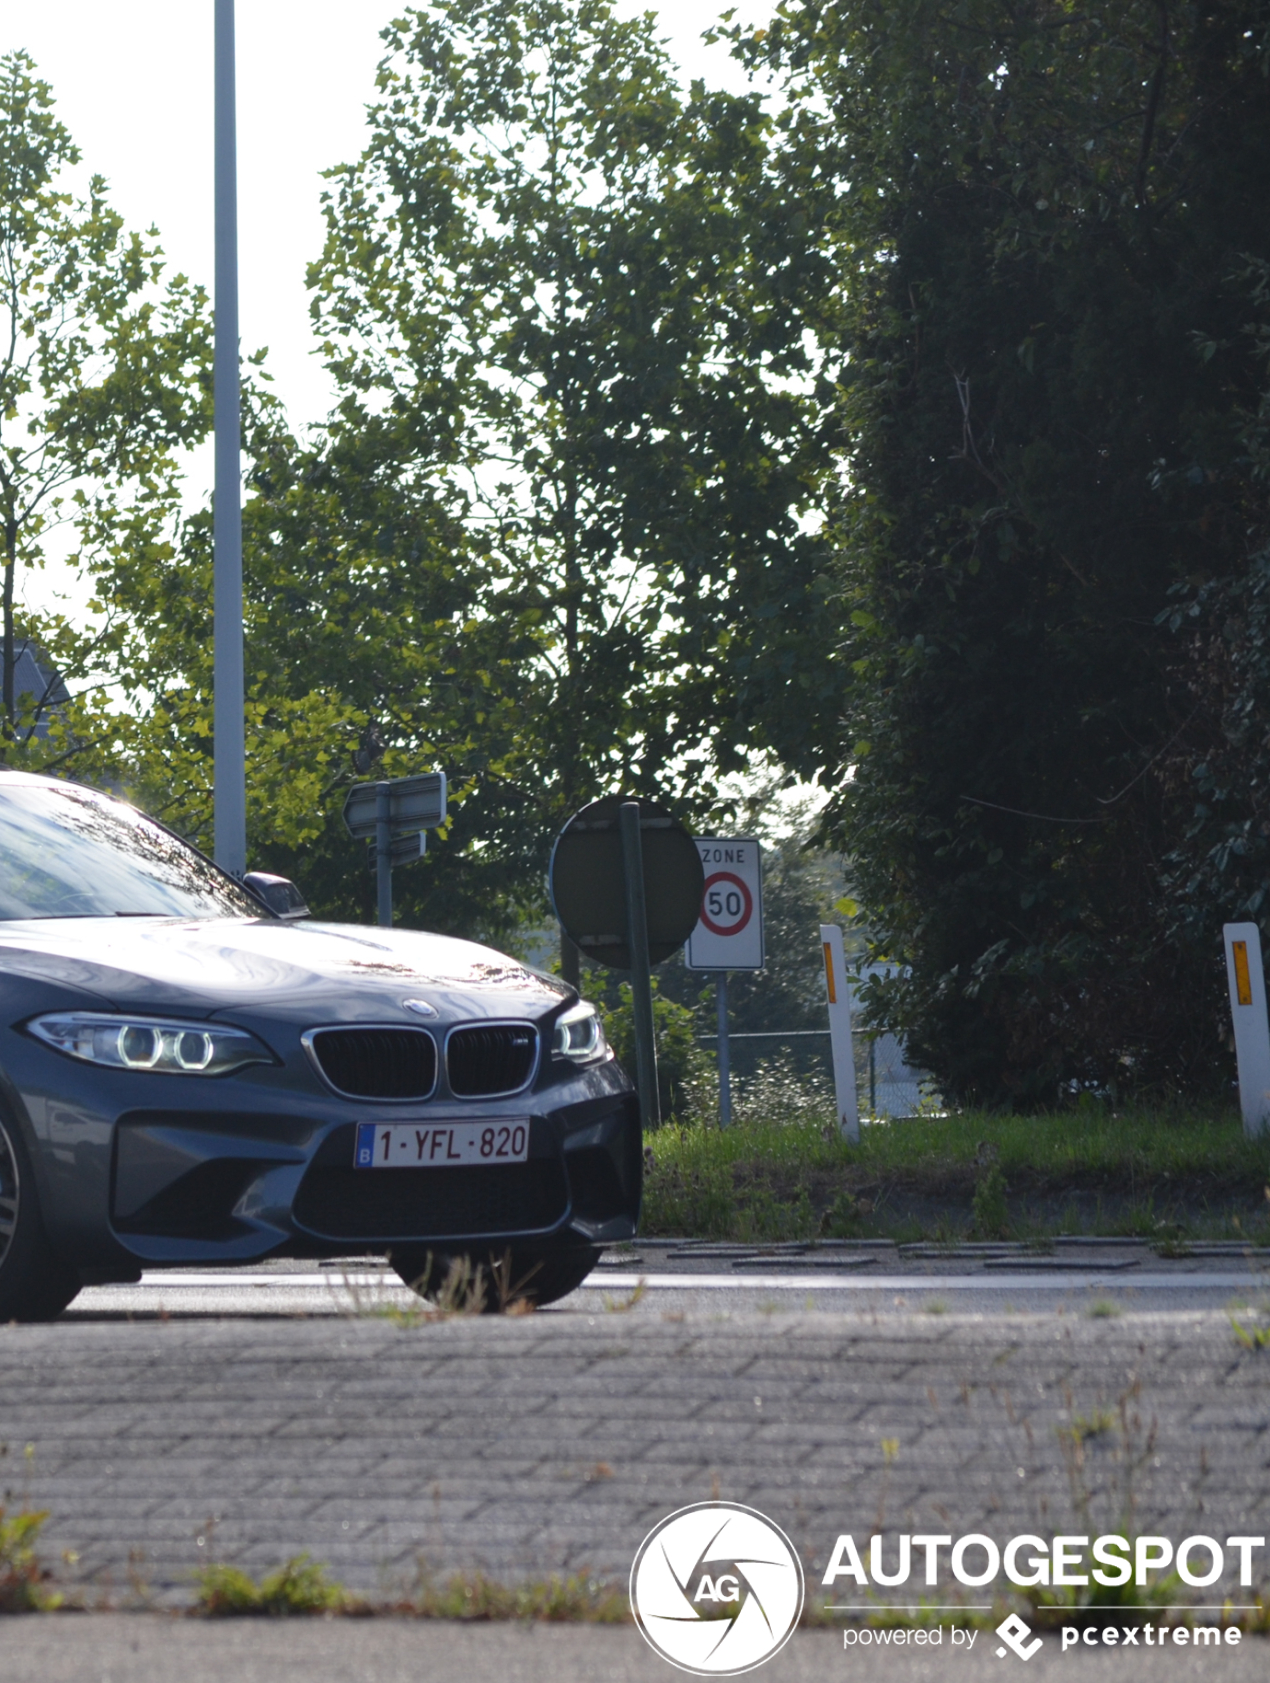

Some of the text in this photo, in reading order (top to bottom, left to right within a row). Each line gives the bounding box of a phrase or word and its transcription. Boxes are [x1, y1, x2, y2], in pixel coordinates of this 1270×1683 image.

[702, 848, 745, 863] ZONE
[708, 891, 741, 917] 50
[359, 1148, 371, 1164] B
